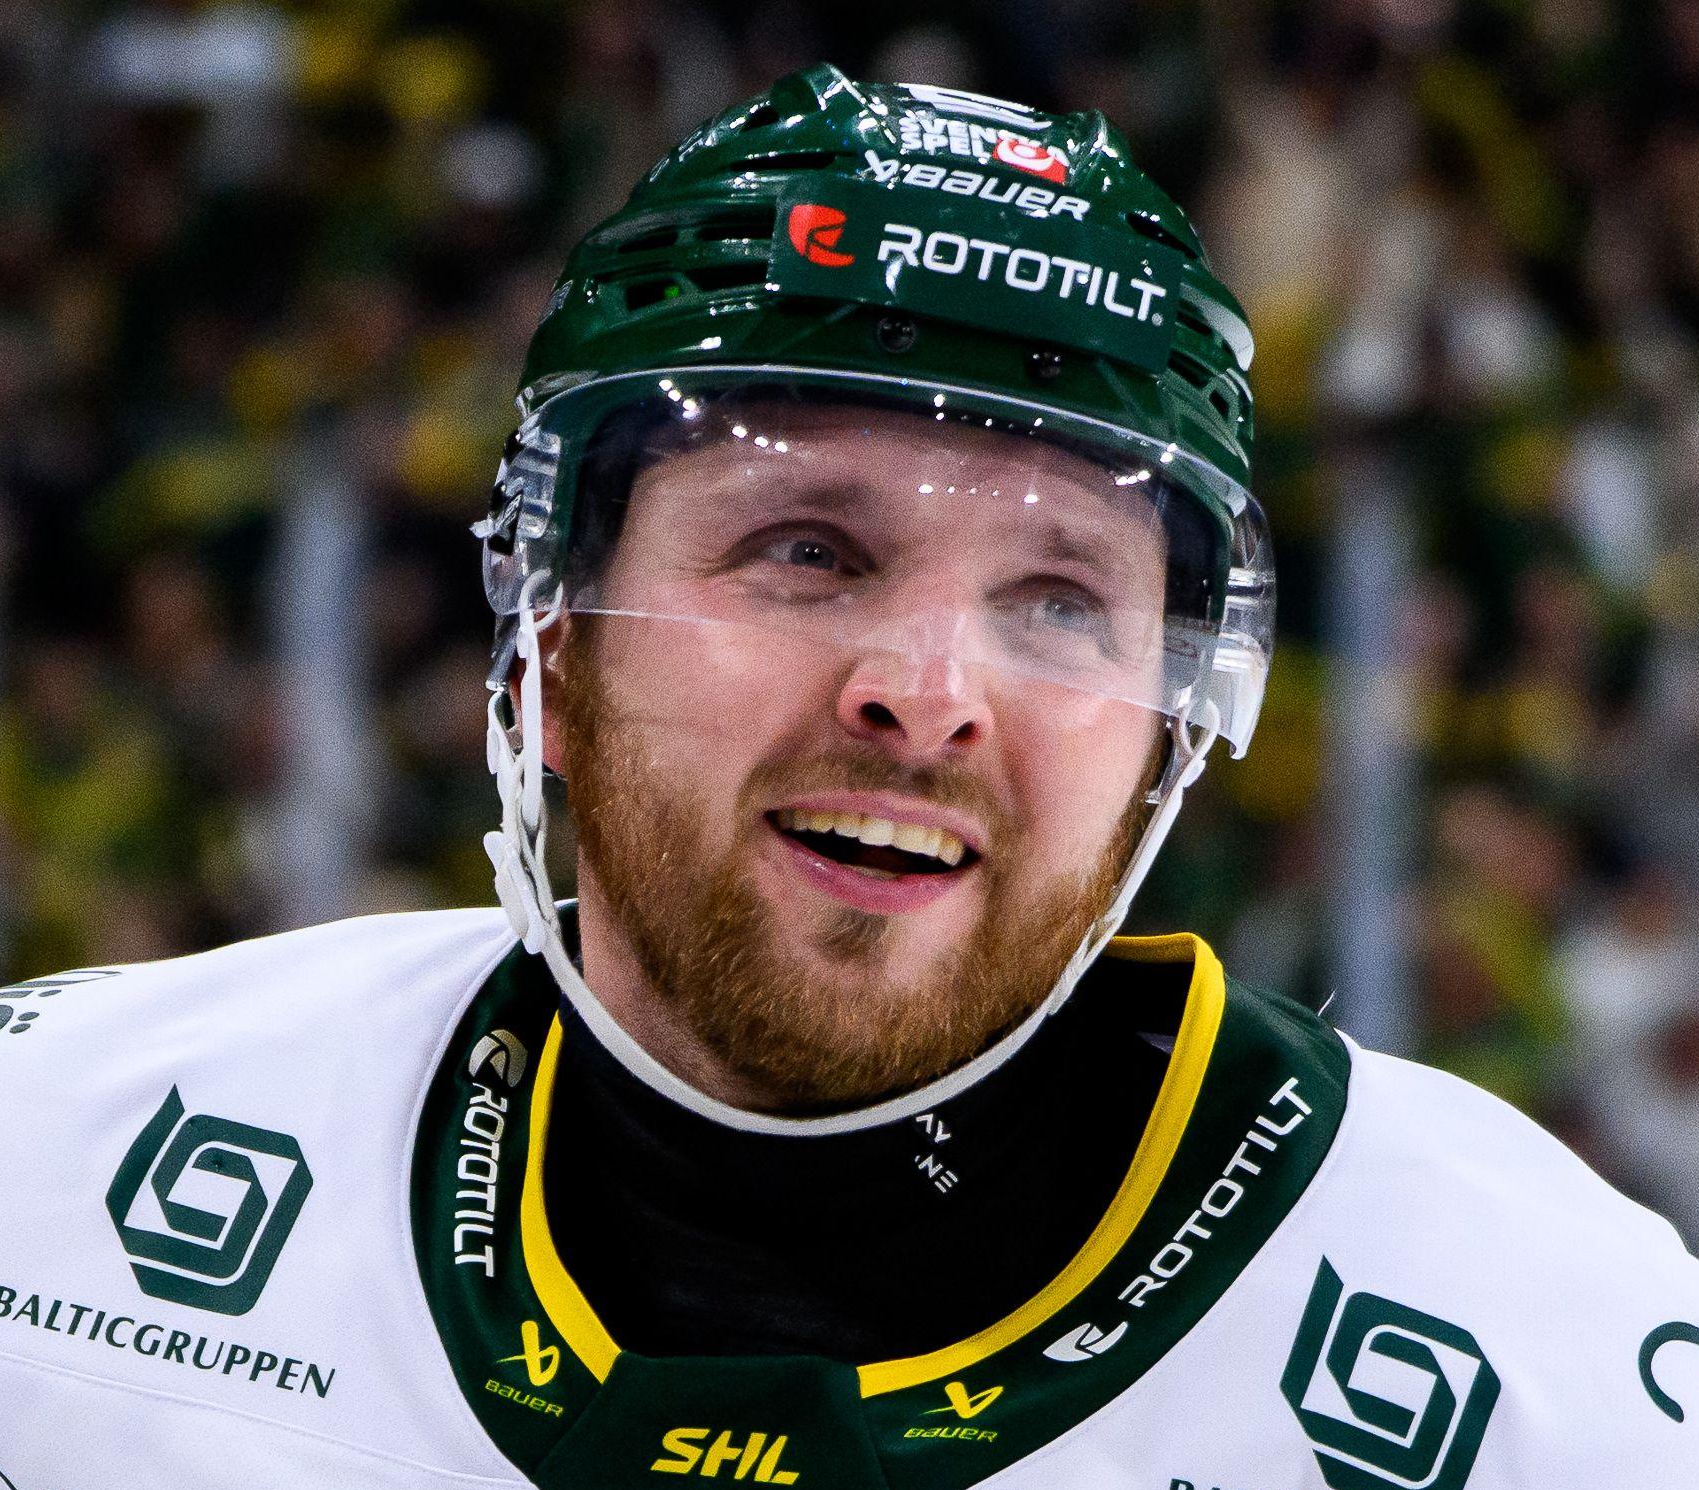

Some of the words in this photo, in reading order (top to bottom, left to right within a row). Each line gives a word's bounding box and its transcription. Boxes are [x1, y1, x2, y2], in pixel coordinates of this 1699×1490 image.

[902, 163, 1092, 222] BAUER
[877, 222, 1167, 322] ROTOTILT
[453, 1081, 508, 1278] ROTOTILT
[1117, 1076, 1313, 1308] ROTOTILT
[484, 1378, 565, 1419] BAUER
[650, 1427, 800, 1486] SHL
[903, 1425, 998, 1444] BAUER
